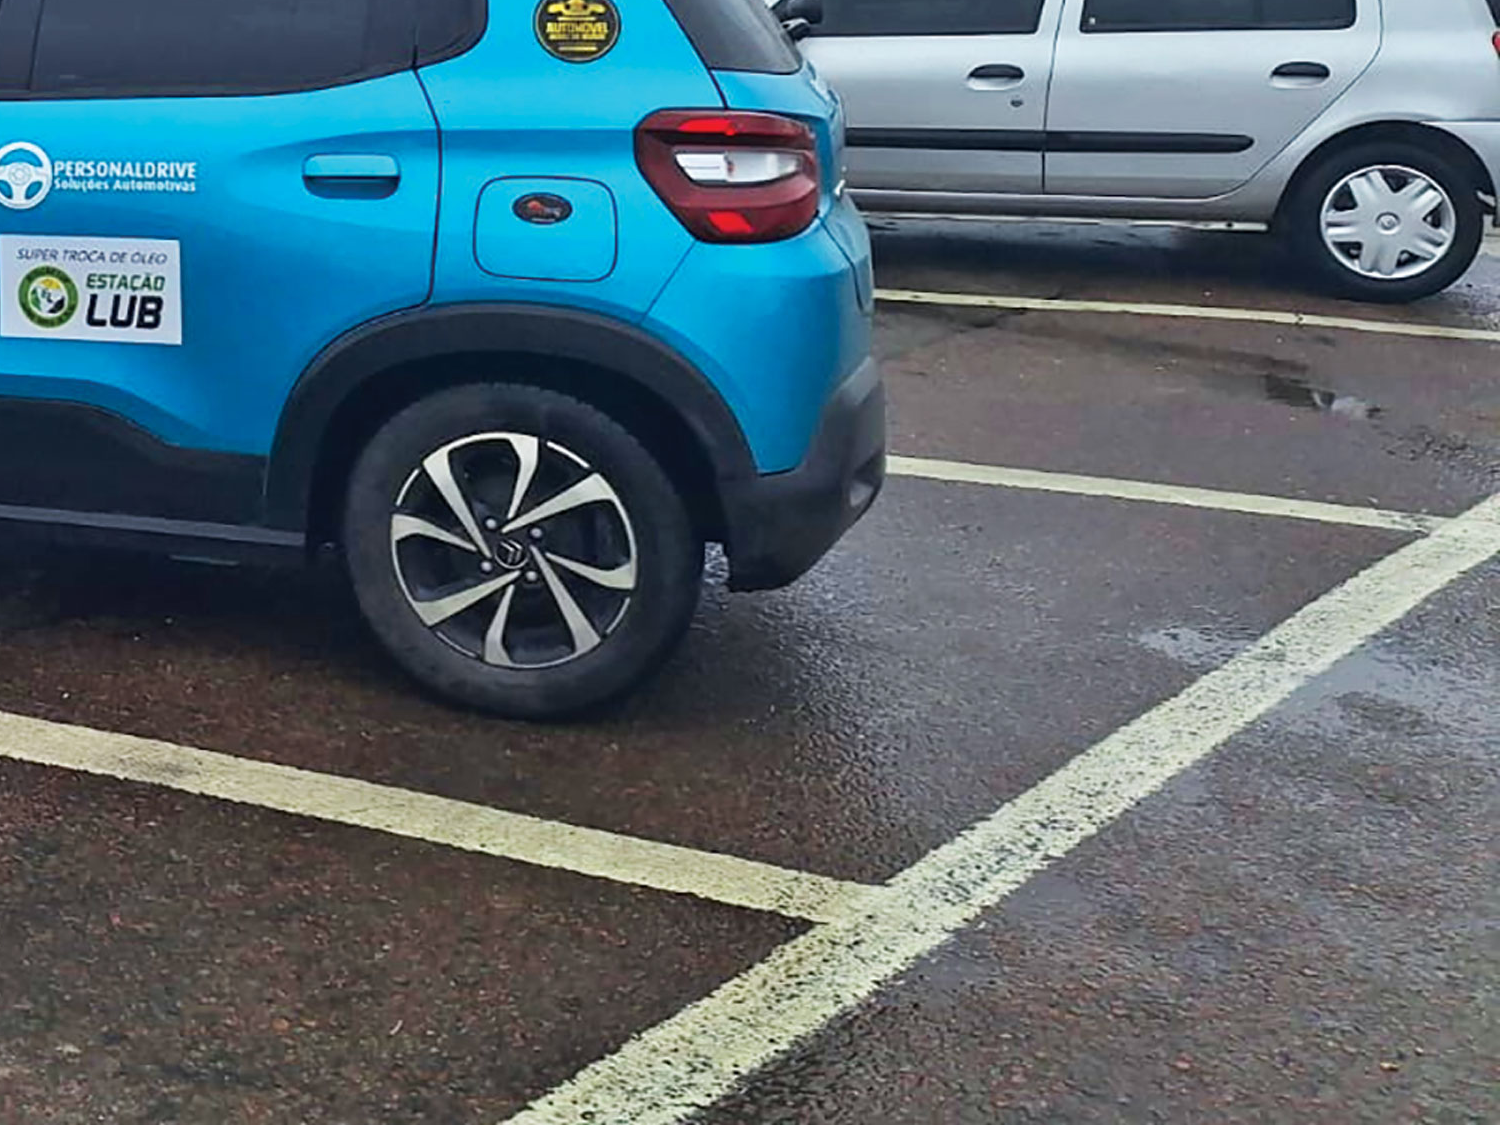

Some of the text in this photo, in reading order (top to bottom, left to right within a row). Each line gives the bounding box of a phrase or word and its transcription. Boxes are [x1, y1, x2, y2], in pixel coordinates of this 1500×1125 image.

[53, 160, 196, 178] PERSONALDRIVE
[53, 178, 196, 192] Soluções Automotivas
[16, 248, 59, 262] SUPER
[62, 249, 105, 263] TROCA
[109, 251, 127, 264] DE
[86, 272, 166, 292] ESTAÇÃO
[86, 293, 164, 329] LUB
